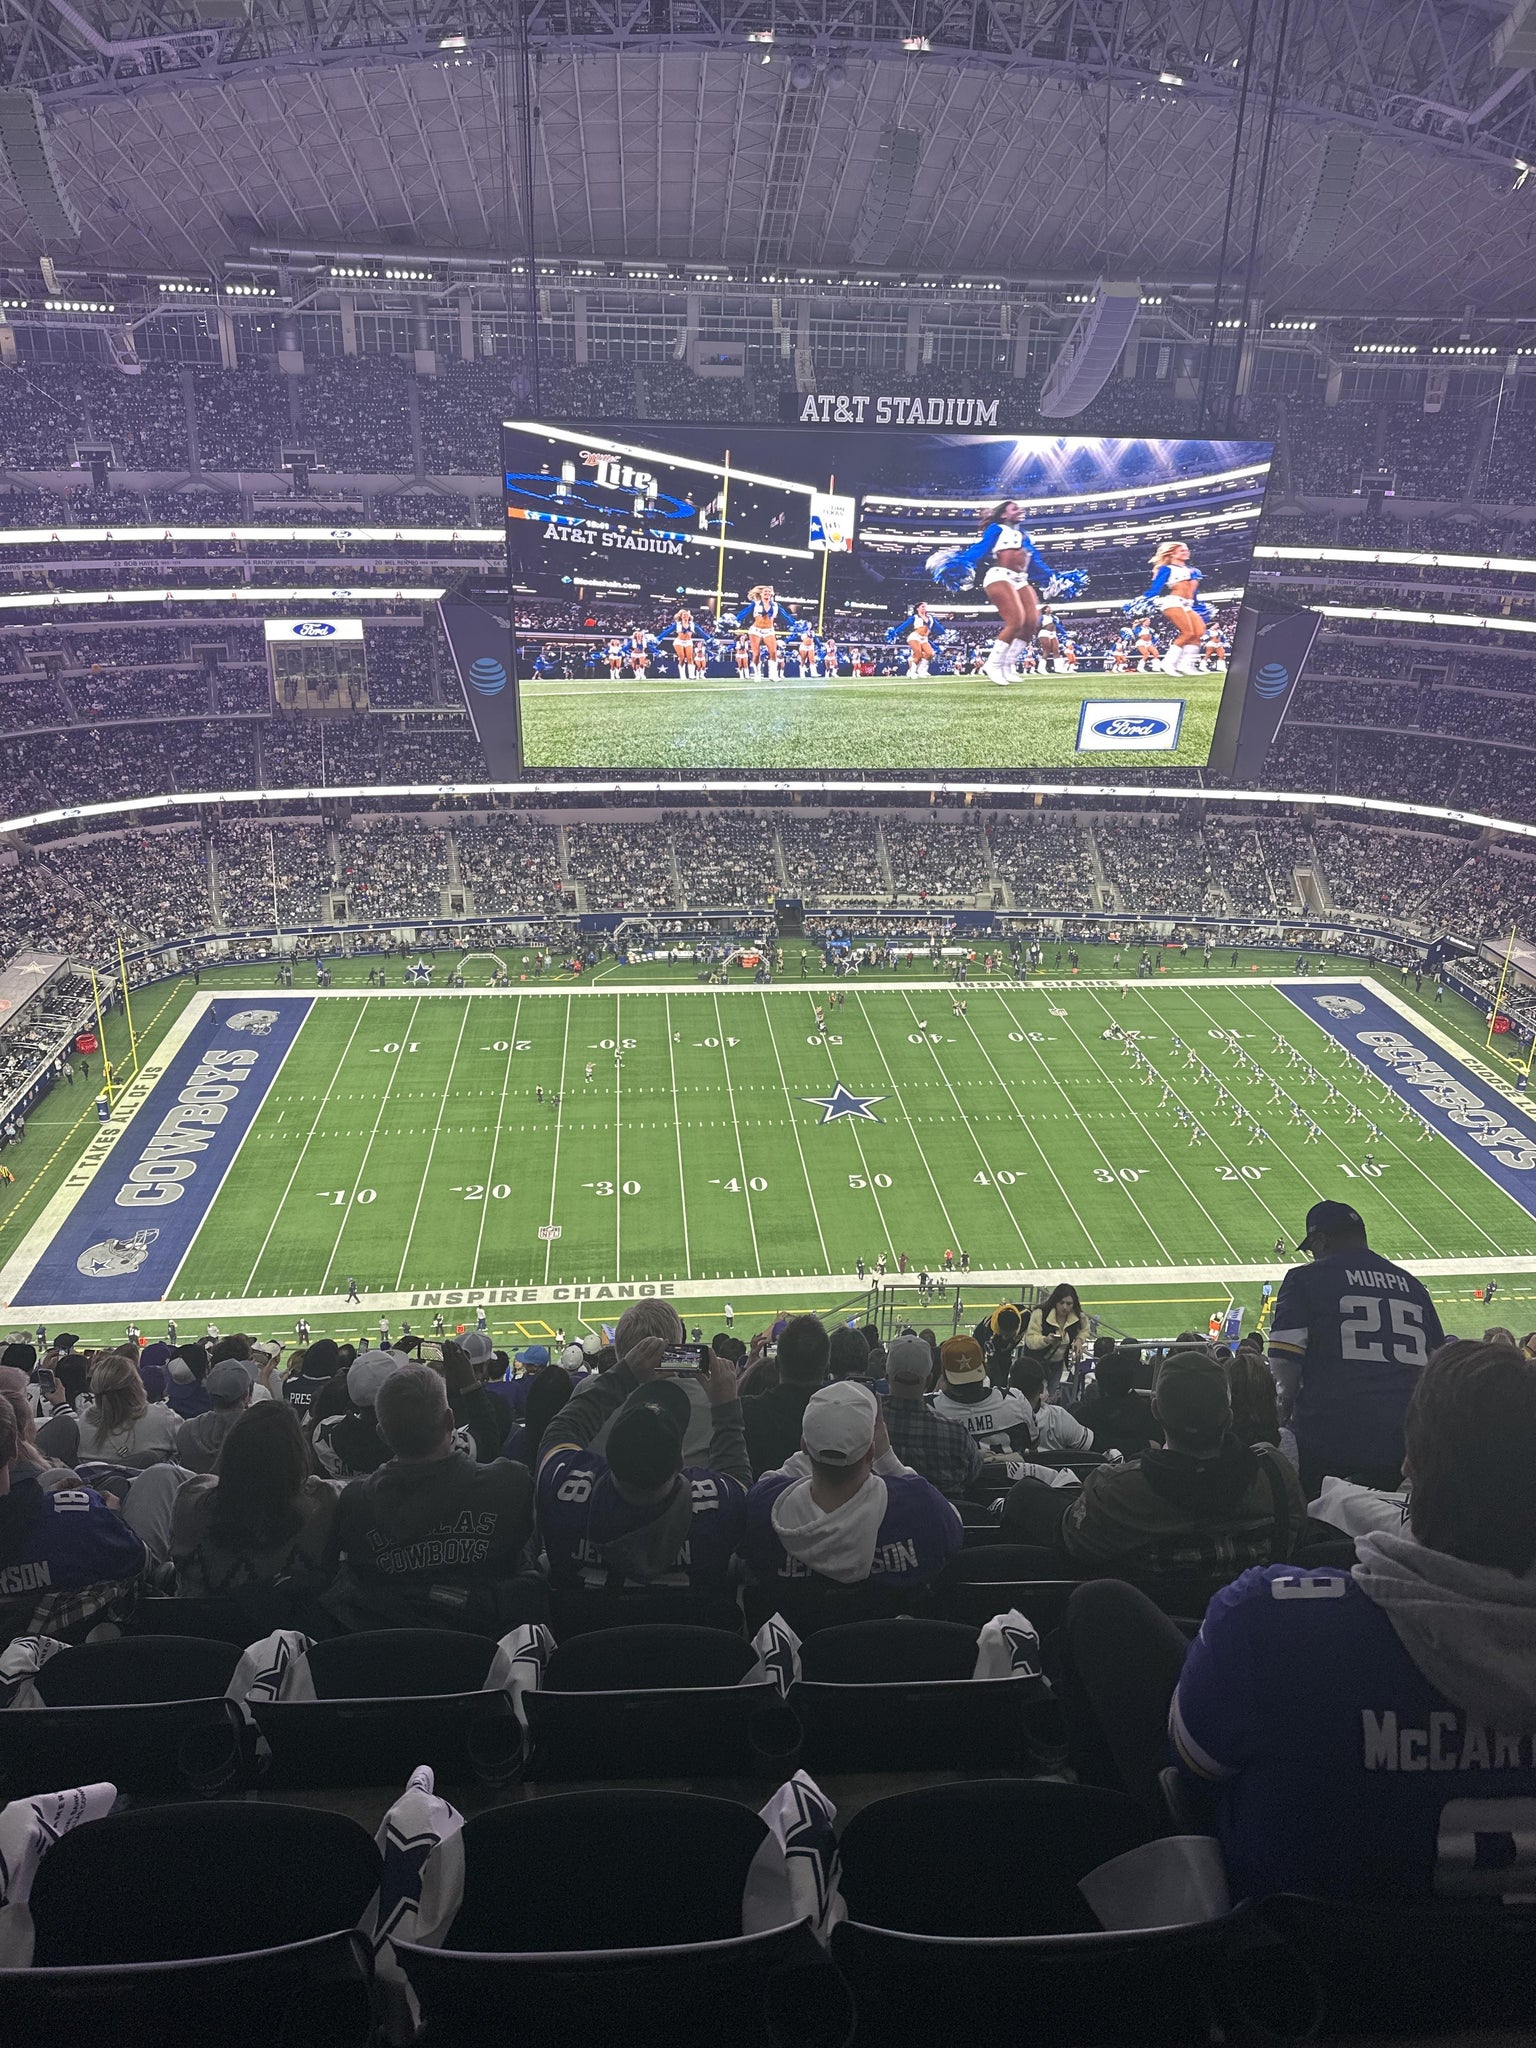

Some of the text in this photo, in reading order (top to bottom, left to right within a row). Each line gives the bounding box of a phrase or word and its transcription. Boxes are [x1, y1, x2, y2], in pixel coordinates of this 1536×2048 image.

[800, 395, 1000, 426] AT&T STADIUM
[594, 460, 652, 489] Lite
[543, 523, 683, 556] AT&T STADIUM
[573, 577, 641, 590] Blockchain.com
[300, 623, 330, 637] Ford
[1105, 718, 1155, 736] Ford
[599, 1038, 638, 1049] 30
[703, 1036, 741, 1047] 40
[806, 1035, 844, 1046] 50
[907, 1032, 945, 1044] 40
[1007, 1031, 1045, 1042] 30
[492, 1040, 533, 1051] 20
[1461, 1058, 1522, 1098] CHOOSE
[1356, 1031, 1536, 1169] COWBOYS
[65, 1066, 163, 1188] IT TAKES ALL OF US
[115, 1049, 260, 1207] COWBOYS
[972, 1170, 1017, 1186] 40
[1093, 1168, 1140, 1183] 30
[1214, 1165, 1263, 1181] 20
[1336, 1162, 1383, 1178] 10
[595, 1180, 642, 1196] 30
[723, 1176, 769, 1193] 40
[848, 1173, 893, 1189] 50
[329, 1188, 377, 1206] 10
[463, 1183, 512, 1200] 20
[1345, 1269, 1410, 1293] MURPH
[411, 1283, 675, 1307] INSPIRE CHANGE
[1339, 1295, 1428, 1367] 25
[290, 1392, 312, 1405] PRES
[967, 1414, 994, 1432] AMB
[557, 1469, 596, 1503] 18
[53, 1490, 90, 1514] 18
[375, 1538, 490, 1574] COWBOYS
